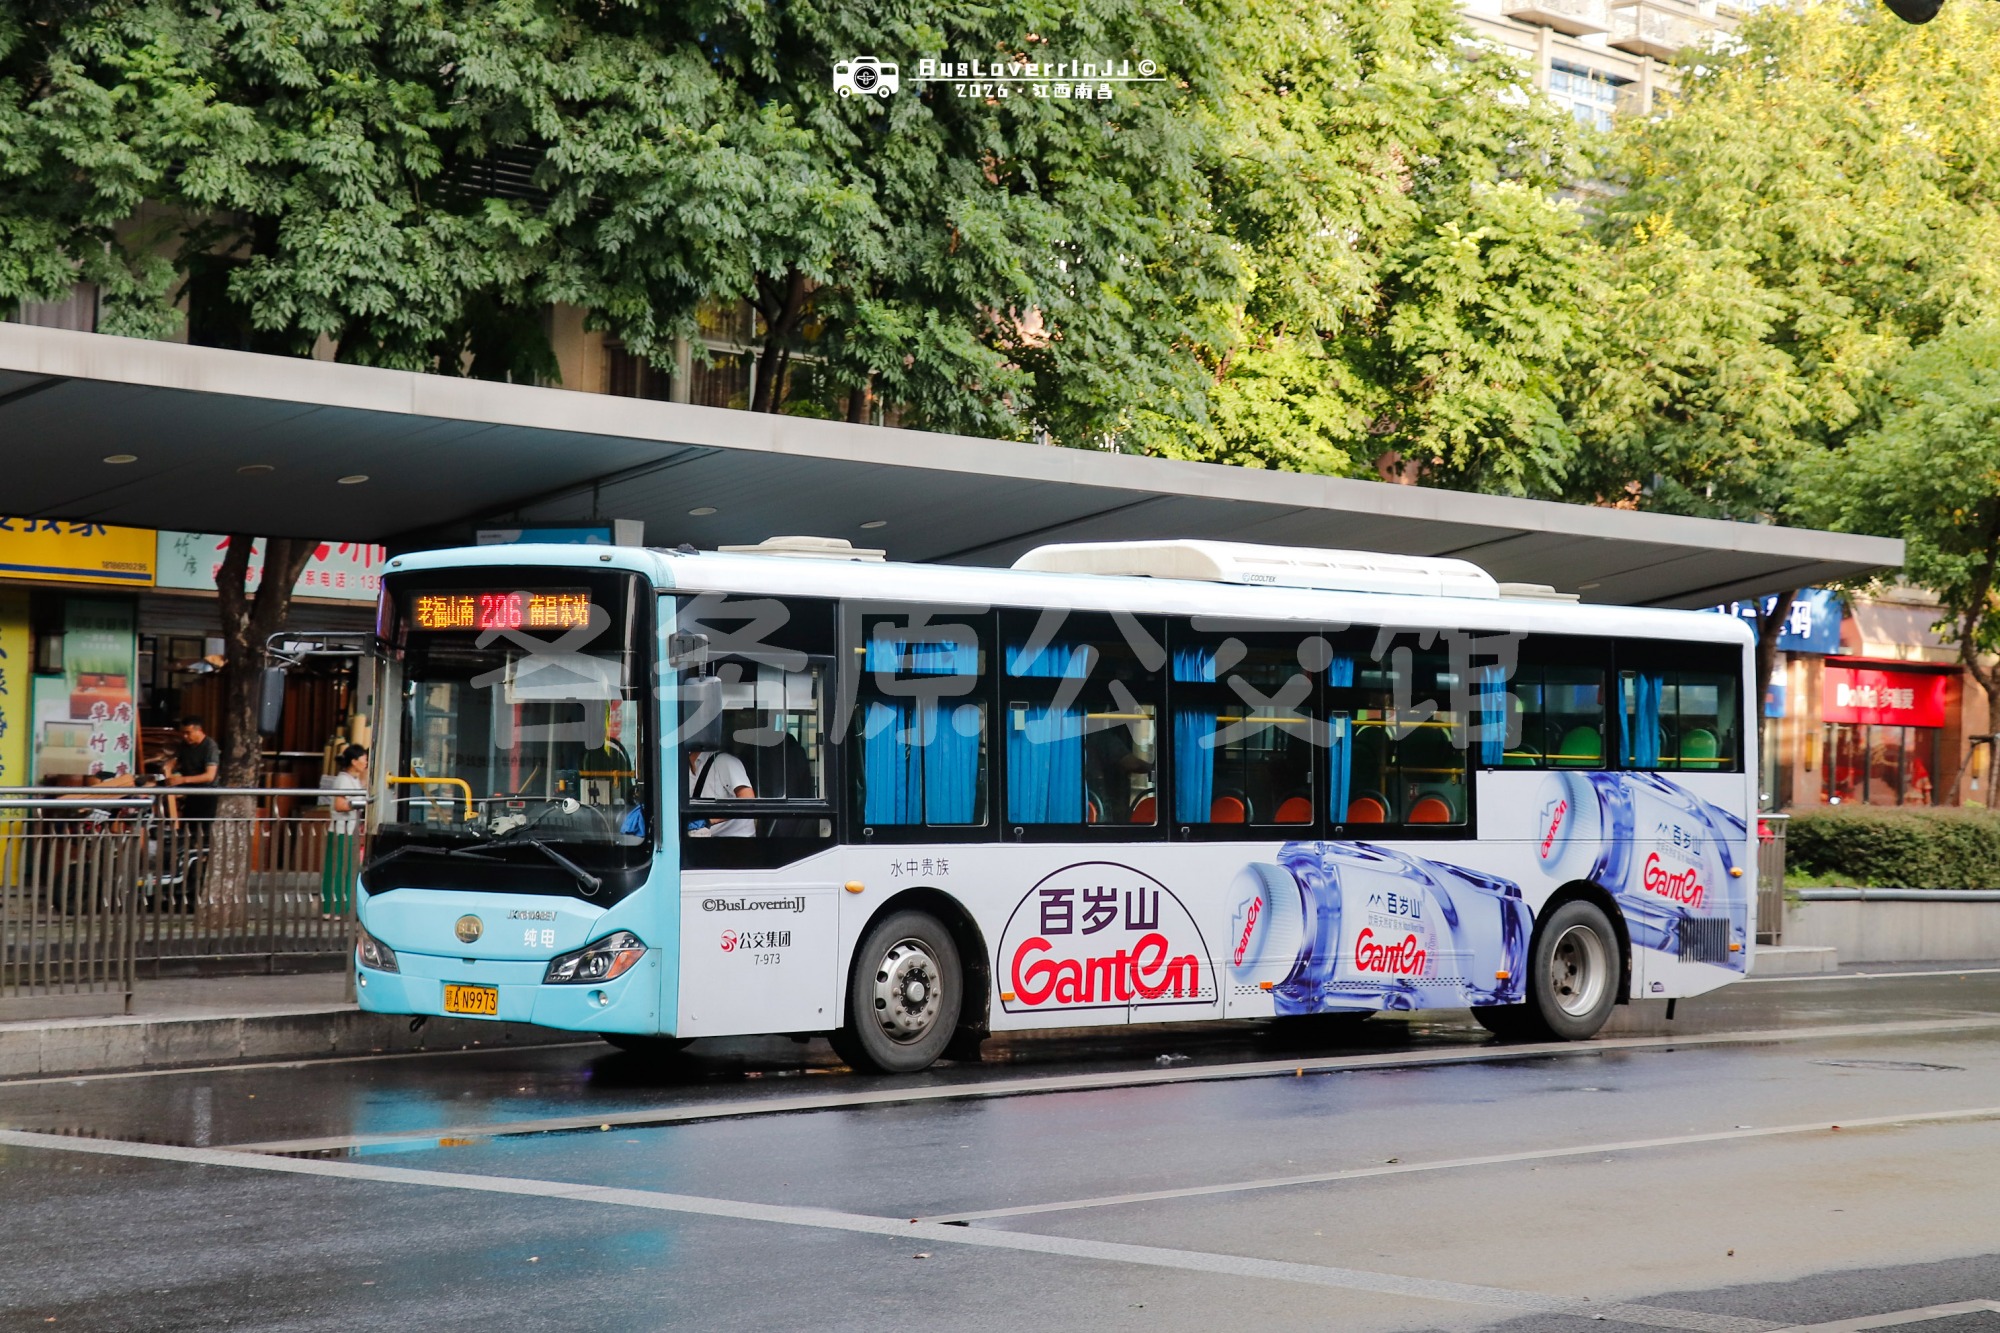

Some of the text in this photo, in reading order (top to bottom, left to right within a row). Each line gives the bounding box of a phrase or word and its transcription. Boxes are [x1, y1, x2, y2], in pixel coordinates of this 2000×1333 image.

[418, 593, 589, 628] 老福山南 206 南昌东站
[90, 733, 130, 753] 竹席
[890, 857, 951, 877] 水中贵族
[1643, 852, 1704, 909] Ganten
[1039, 886, 1159, 935] 百岁山
[1387, 892, 1421, 919] 百岁山
[523, 928, 556, 948] 纯电
[739, 930, 791, 950] 公交集团
[1355, 927, 1427, 976] Ganten
[753, 953, 781, 965] 7-973
[1011, 932, 1199, 1006] Ganten
